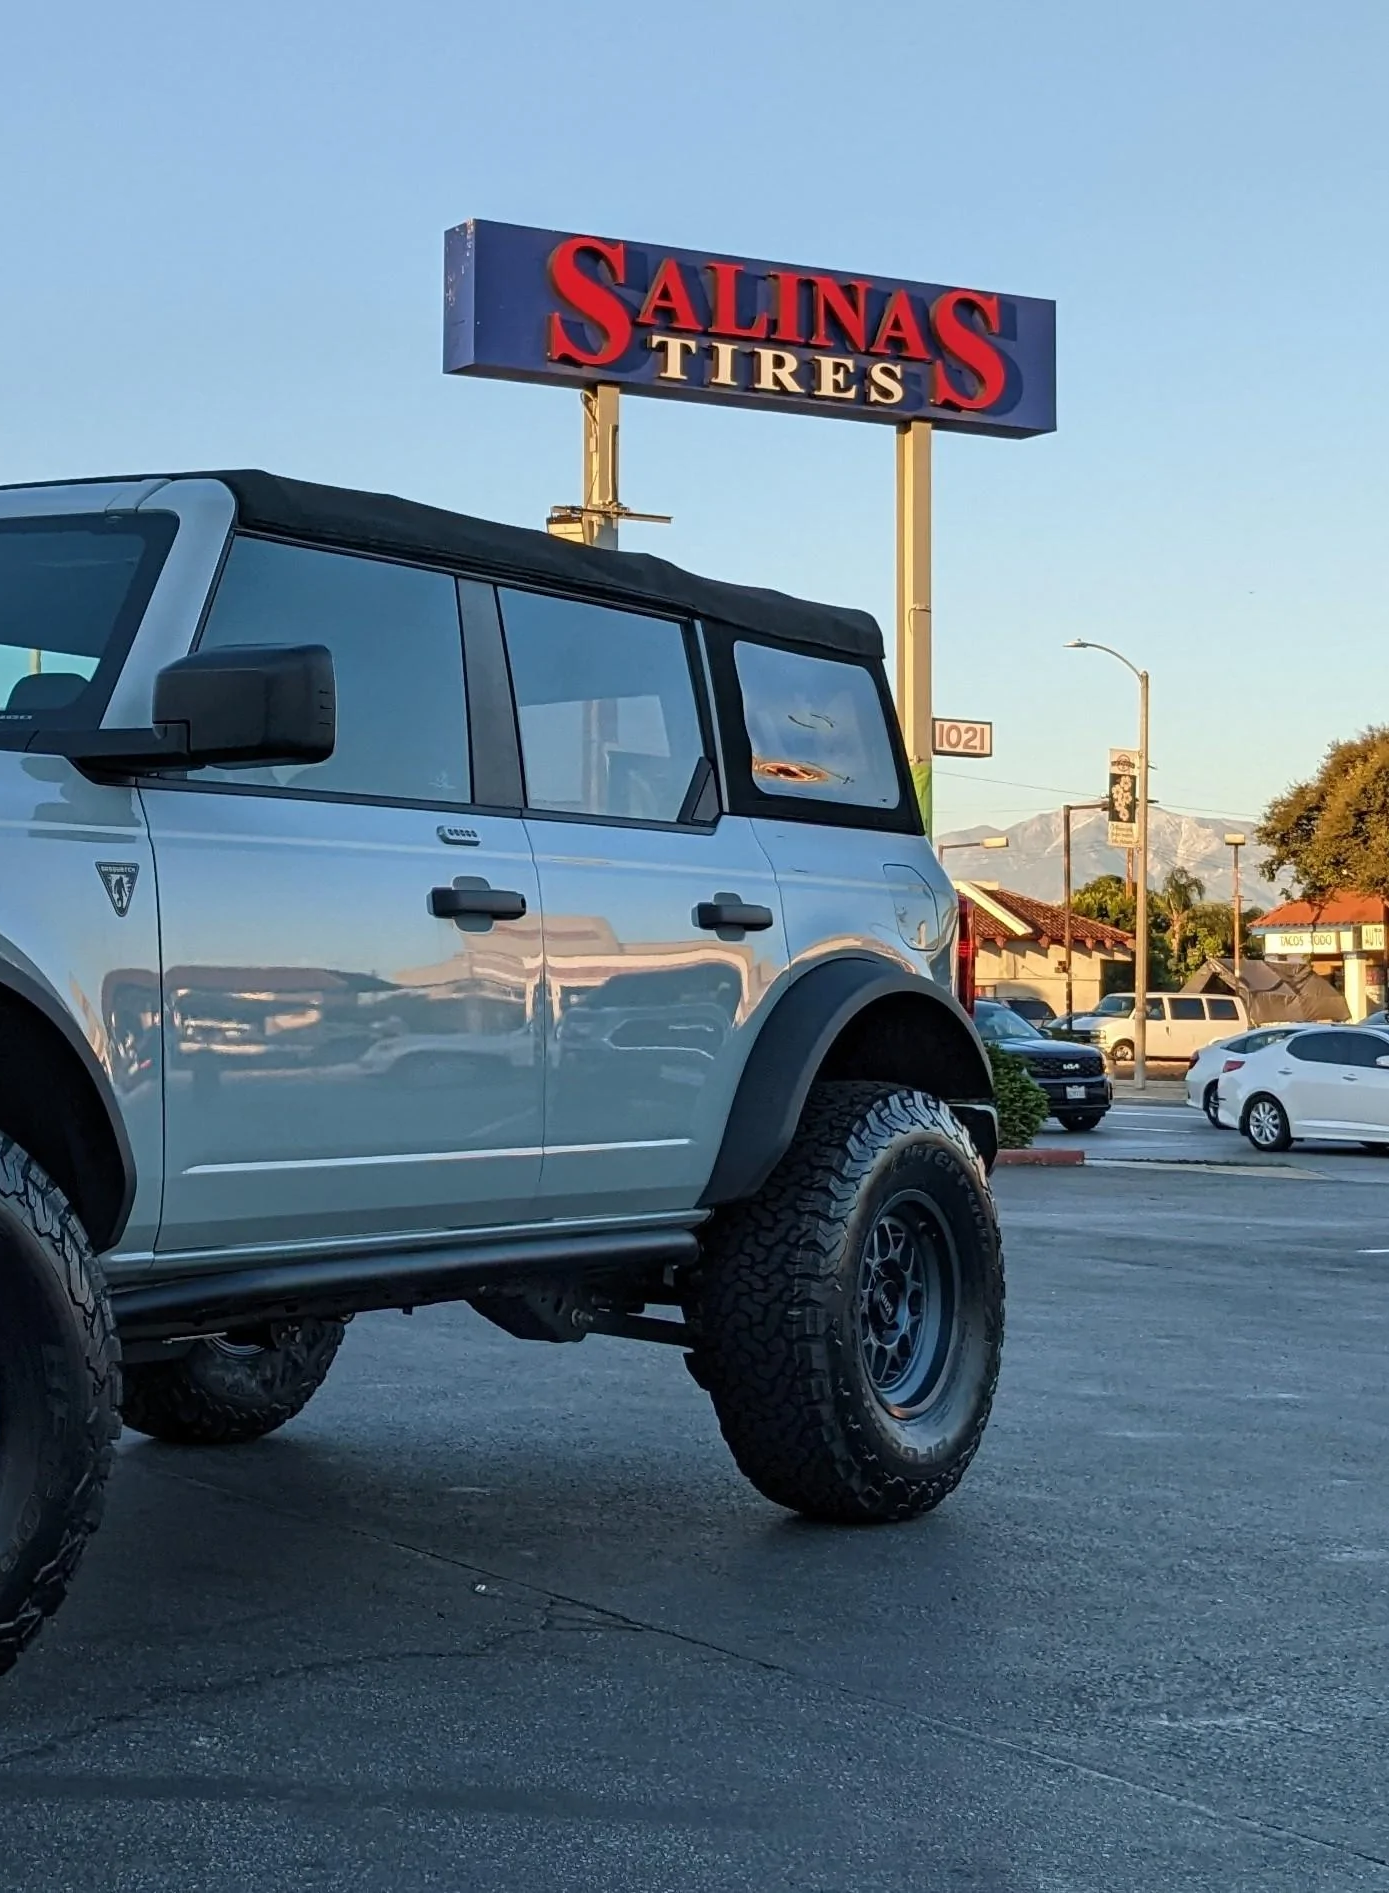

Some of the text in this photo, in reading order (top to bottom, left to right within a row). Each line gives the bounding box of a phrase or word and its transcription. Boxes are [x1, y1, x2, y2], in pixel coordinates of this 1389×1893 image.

[547, 236, 1005, 412] SALINAS
[649, 333, 905, 405] TIRES
[937, 723, 985, 751] 1021
[1280, 935, 1304, 946] TACOS
